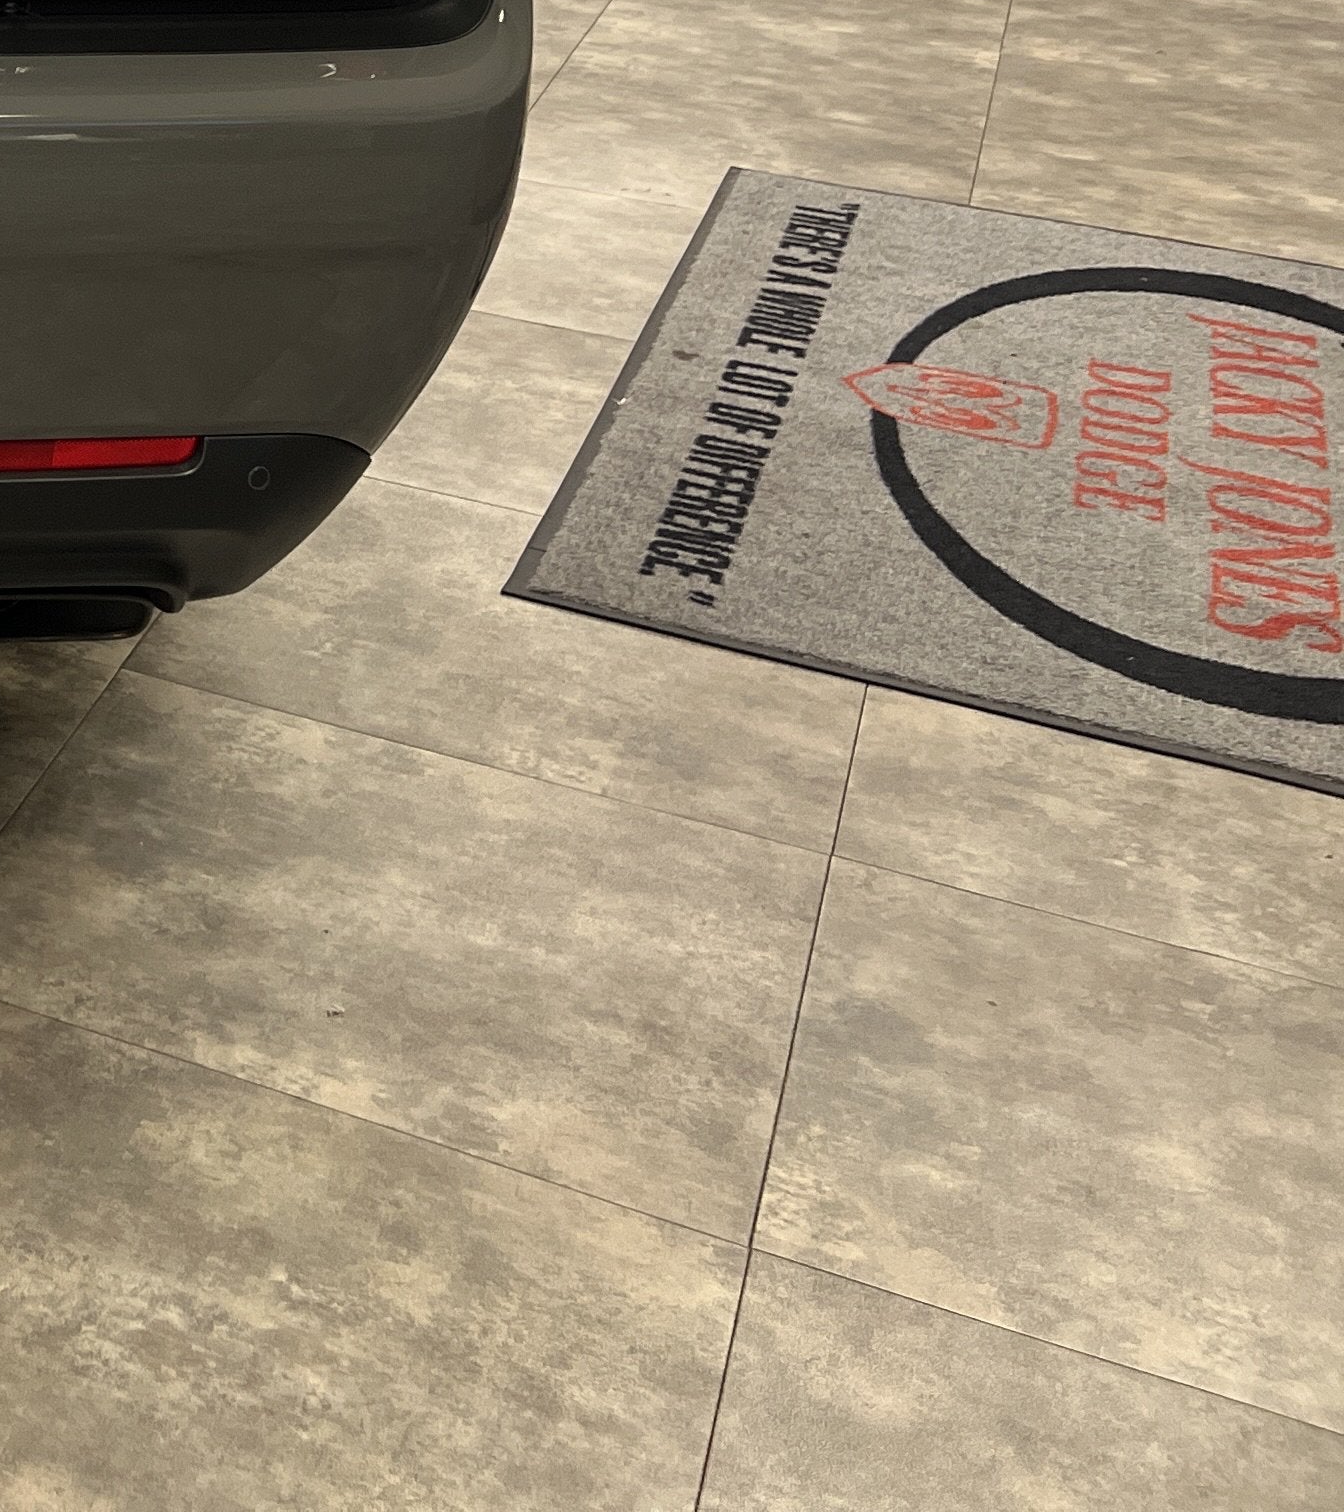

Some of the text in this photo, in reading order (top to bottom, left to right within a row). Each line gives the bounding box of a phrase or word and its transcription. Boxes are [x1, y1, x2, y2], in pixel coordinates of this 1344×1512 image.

[765, 268, 833, 291] A
[735, 287, 828, 359] WHOLE
[717, 358, 800, 407] LOT
[703, 401, 783, 440] OF
[1073, 356, 1172, 522] DODGE
[1176, 312, 1344, 654] JACKY JONES
